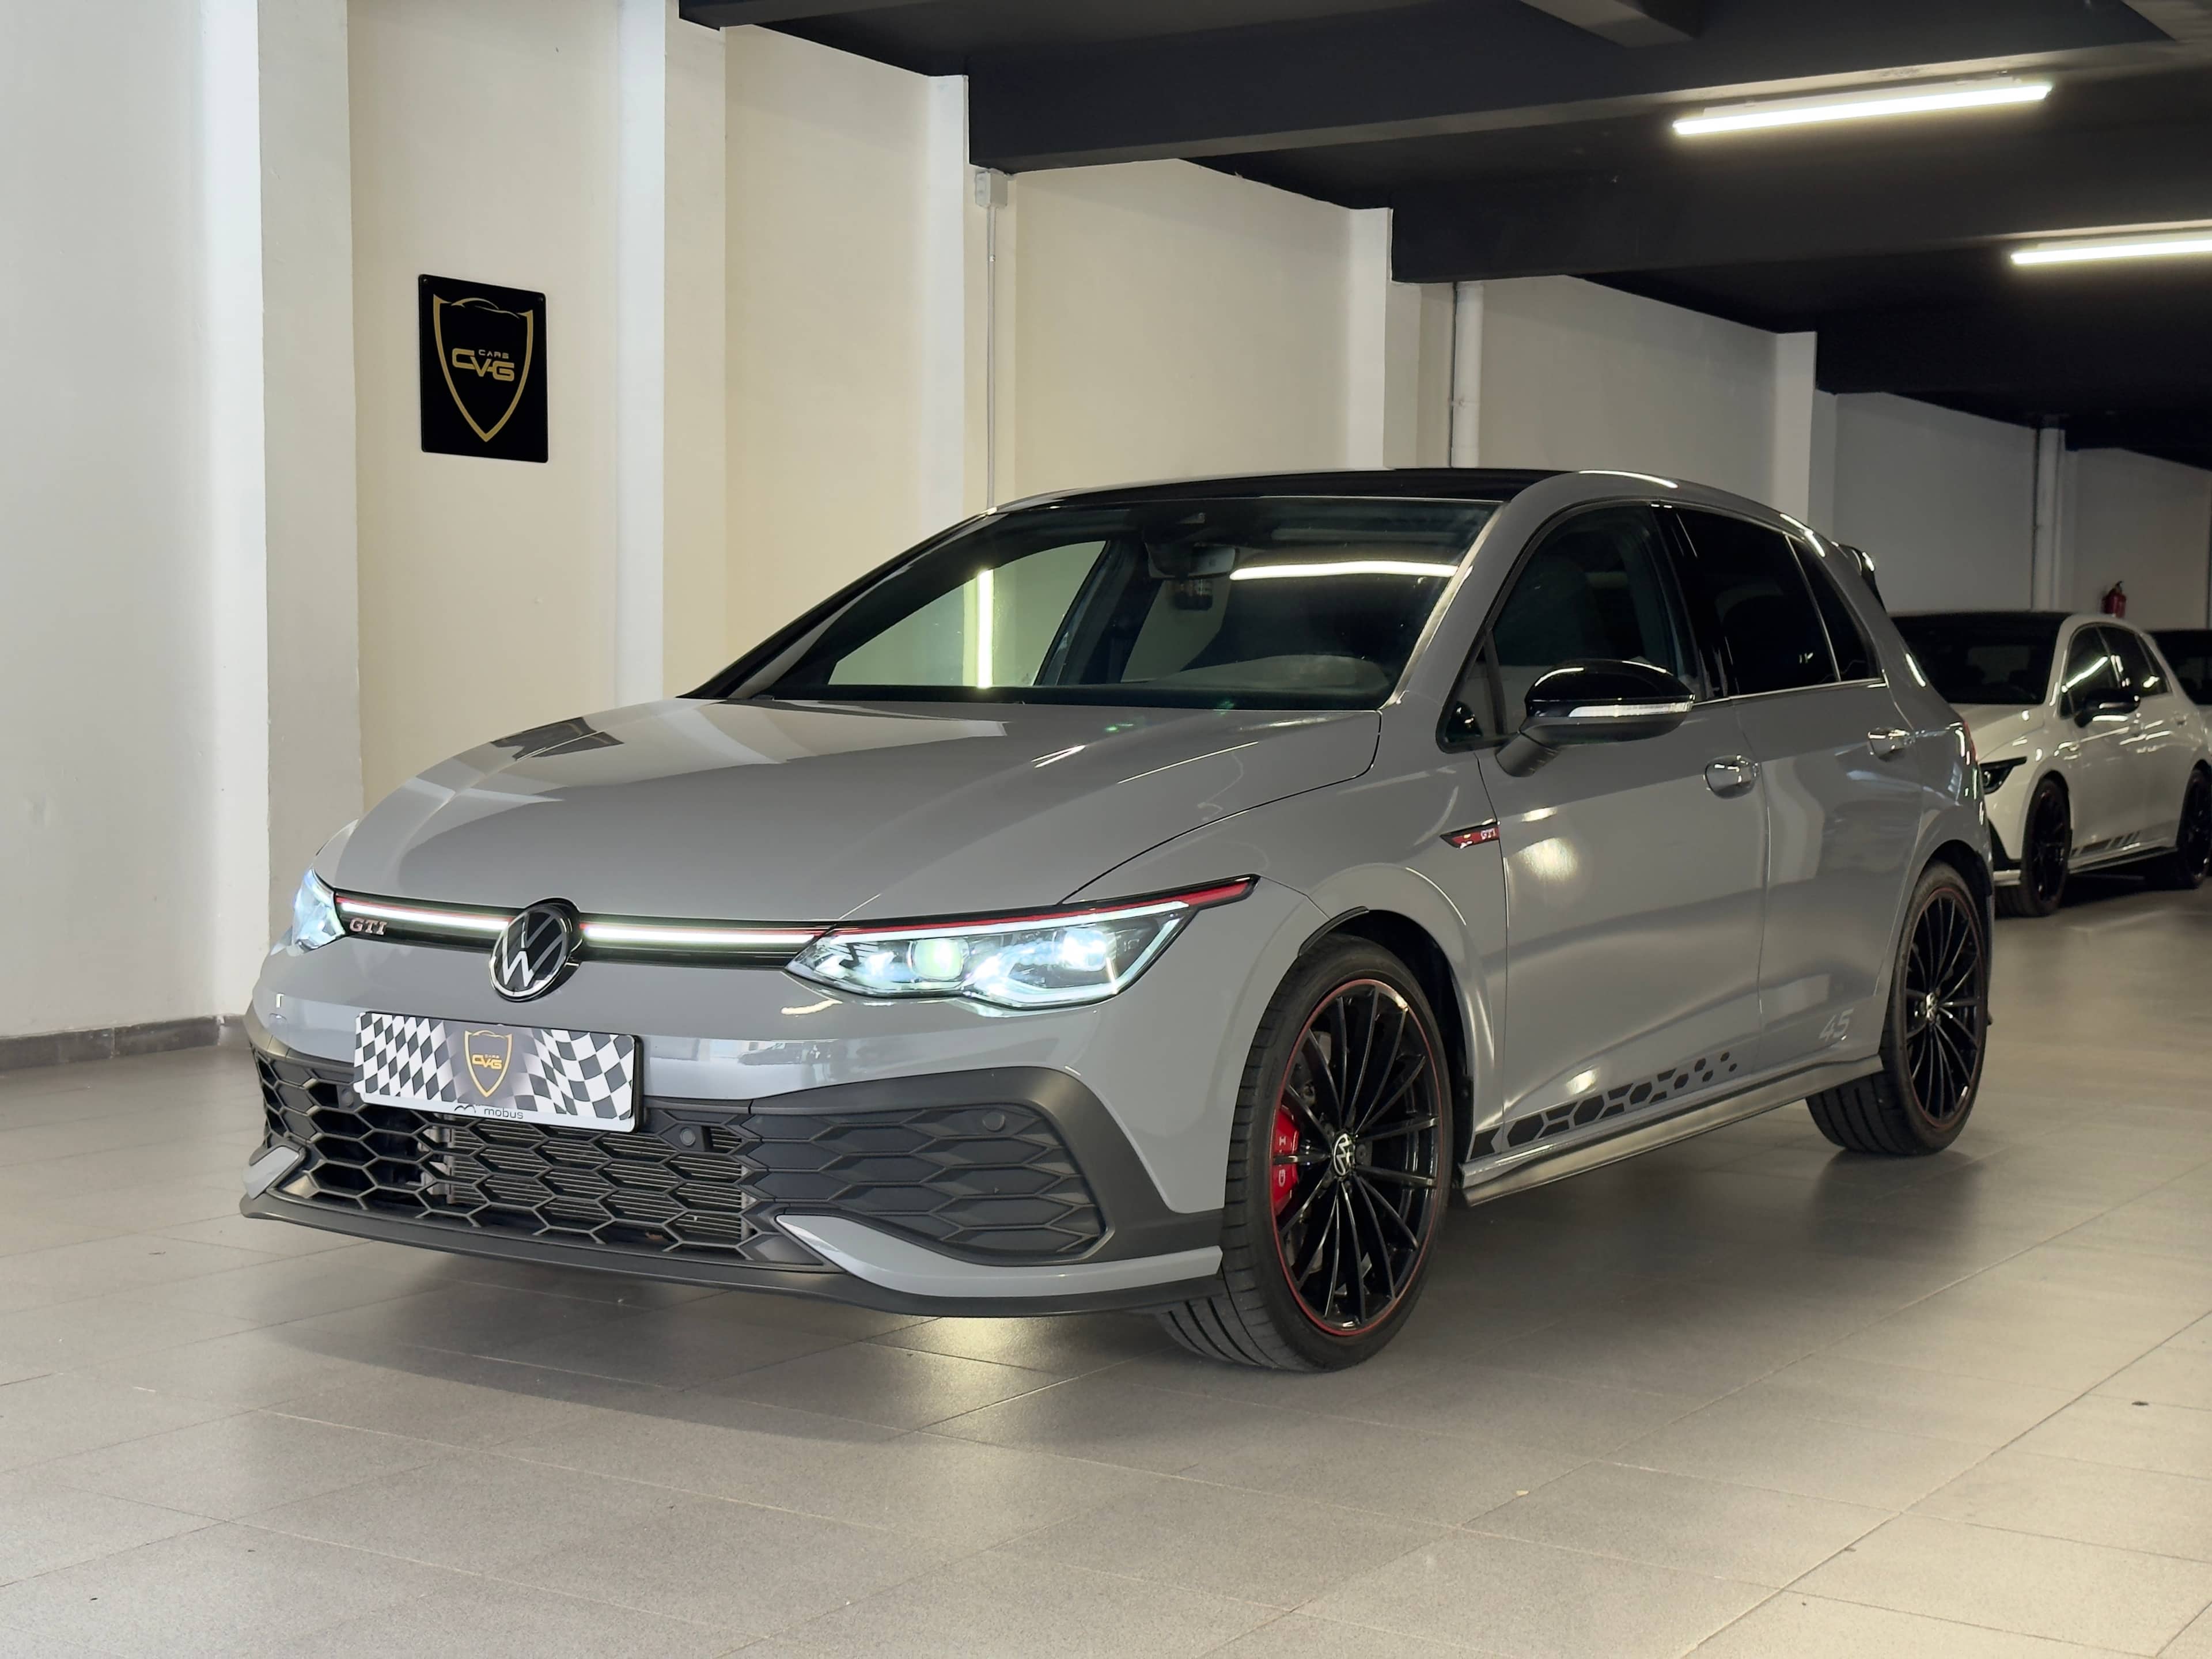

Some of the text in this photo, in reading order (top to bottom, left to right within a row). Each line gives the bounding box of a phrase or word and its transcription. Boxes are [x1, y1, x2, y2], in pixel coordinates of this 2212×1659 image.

[479, 350, 509, 359] CARS
[452, 348, 514, 381] CVG
[1480, 828, 1496, 840] GTI
[350, 917, 387, 935] GTI
[1819, 1008, 1854, 1041] 45
[472, 1054, 502, 1070] CVG
[484, 1107, 524, 1119] mobus
